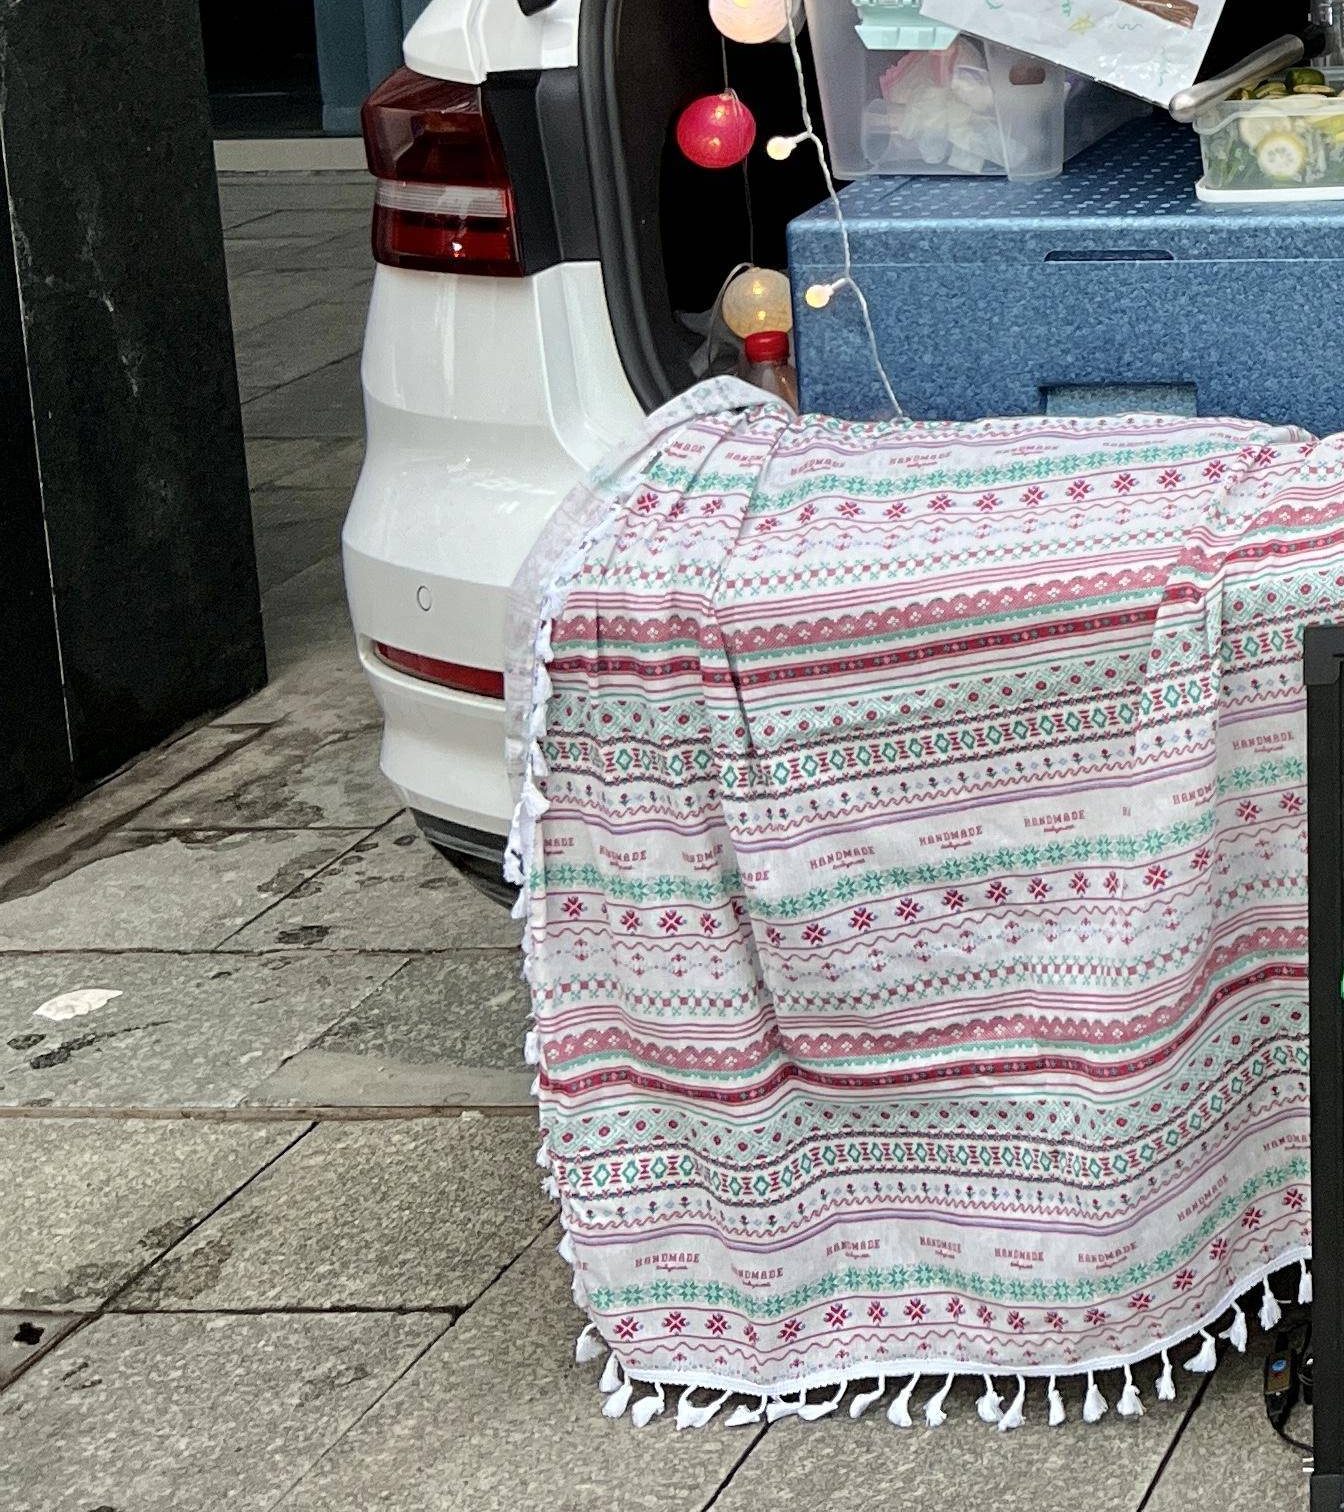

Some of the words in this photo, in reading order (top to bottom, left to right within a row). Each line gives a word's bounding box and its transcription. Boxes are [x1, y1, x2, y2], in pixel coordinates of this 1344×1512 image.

[1231, 730, 1295, 751] HANDMADE
[1024, 809, 1087, 828] HANDMADE
[918, 824, 984, 847] HANDMADE
[809, 845, 877, 870] HANDMADE
[826, 1238, 881, 1257] HANDMADE
[994, 1247, 1045, 1262] HANDMADE
[1077, 1241, 1138, 1264] HANDMADE
[634, 1252, 701, 1269] HANDMADE
